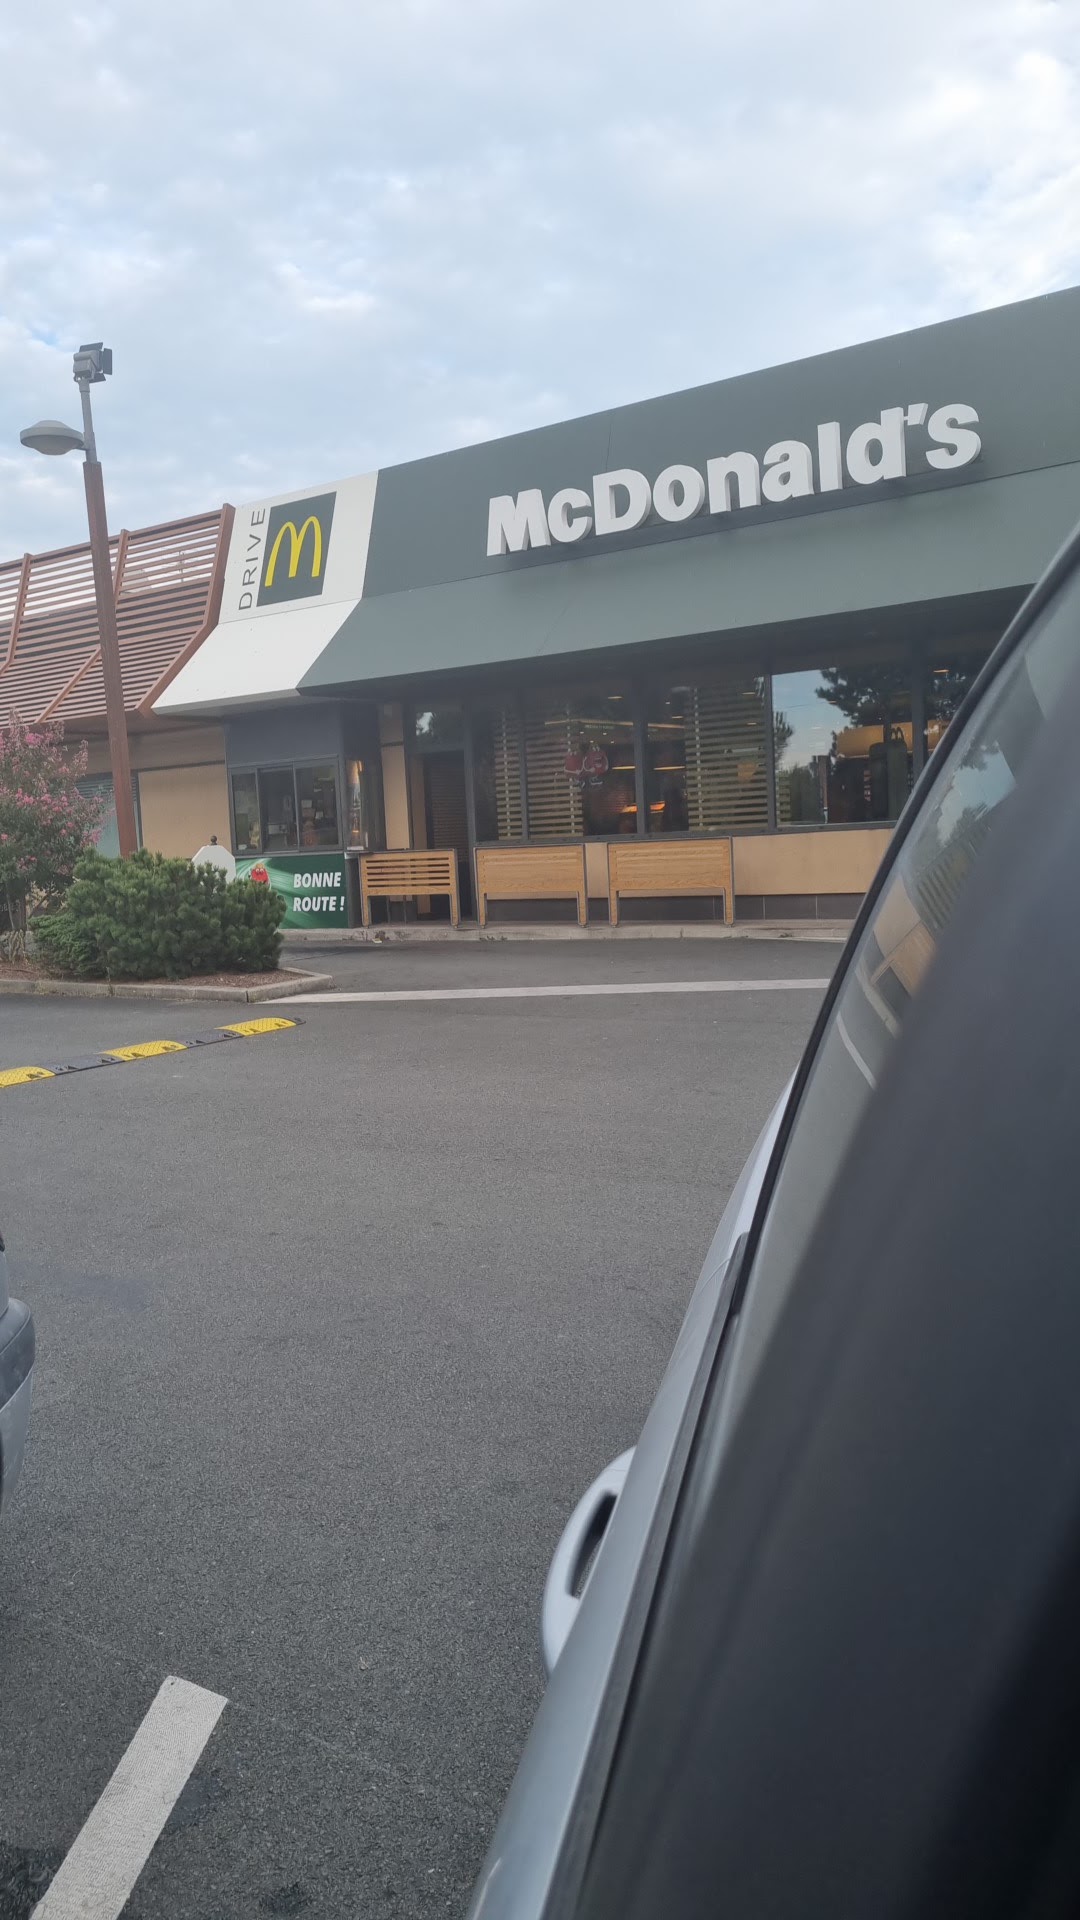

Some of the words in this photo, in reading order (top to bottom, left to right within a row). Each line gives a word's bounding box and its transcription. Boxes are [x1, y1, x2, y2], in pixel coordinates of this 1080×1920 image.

[487, 403, 982, 556] McDonald's
[238, 508, 265, 610] DRIVE
[293, 872, 341, 888] BONNE
